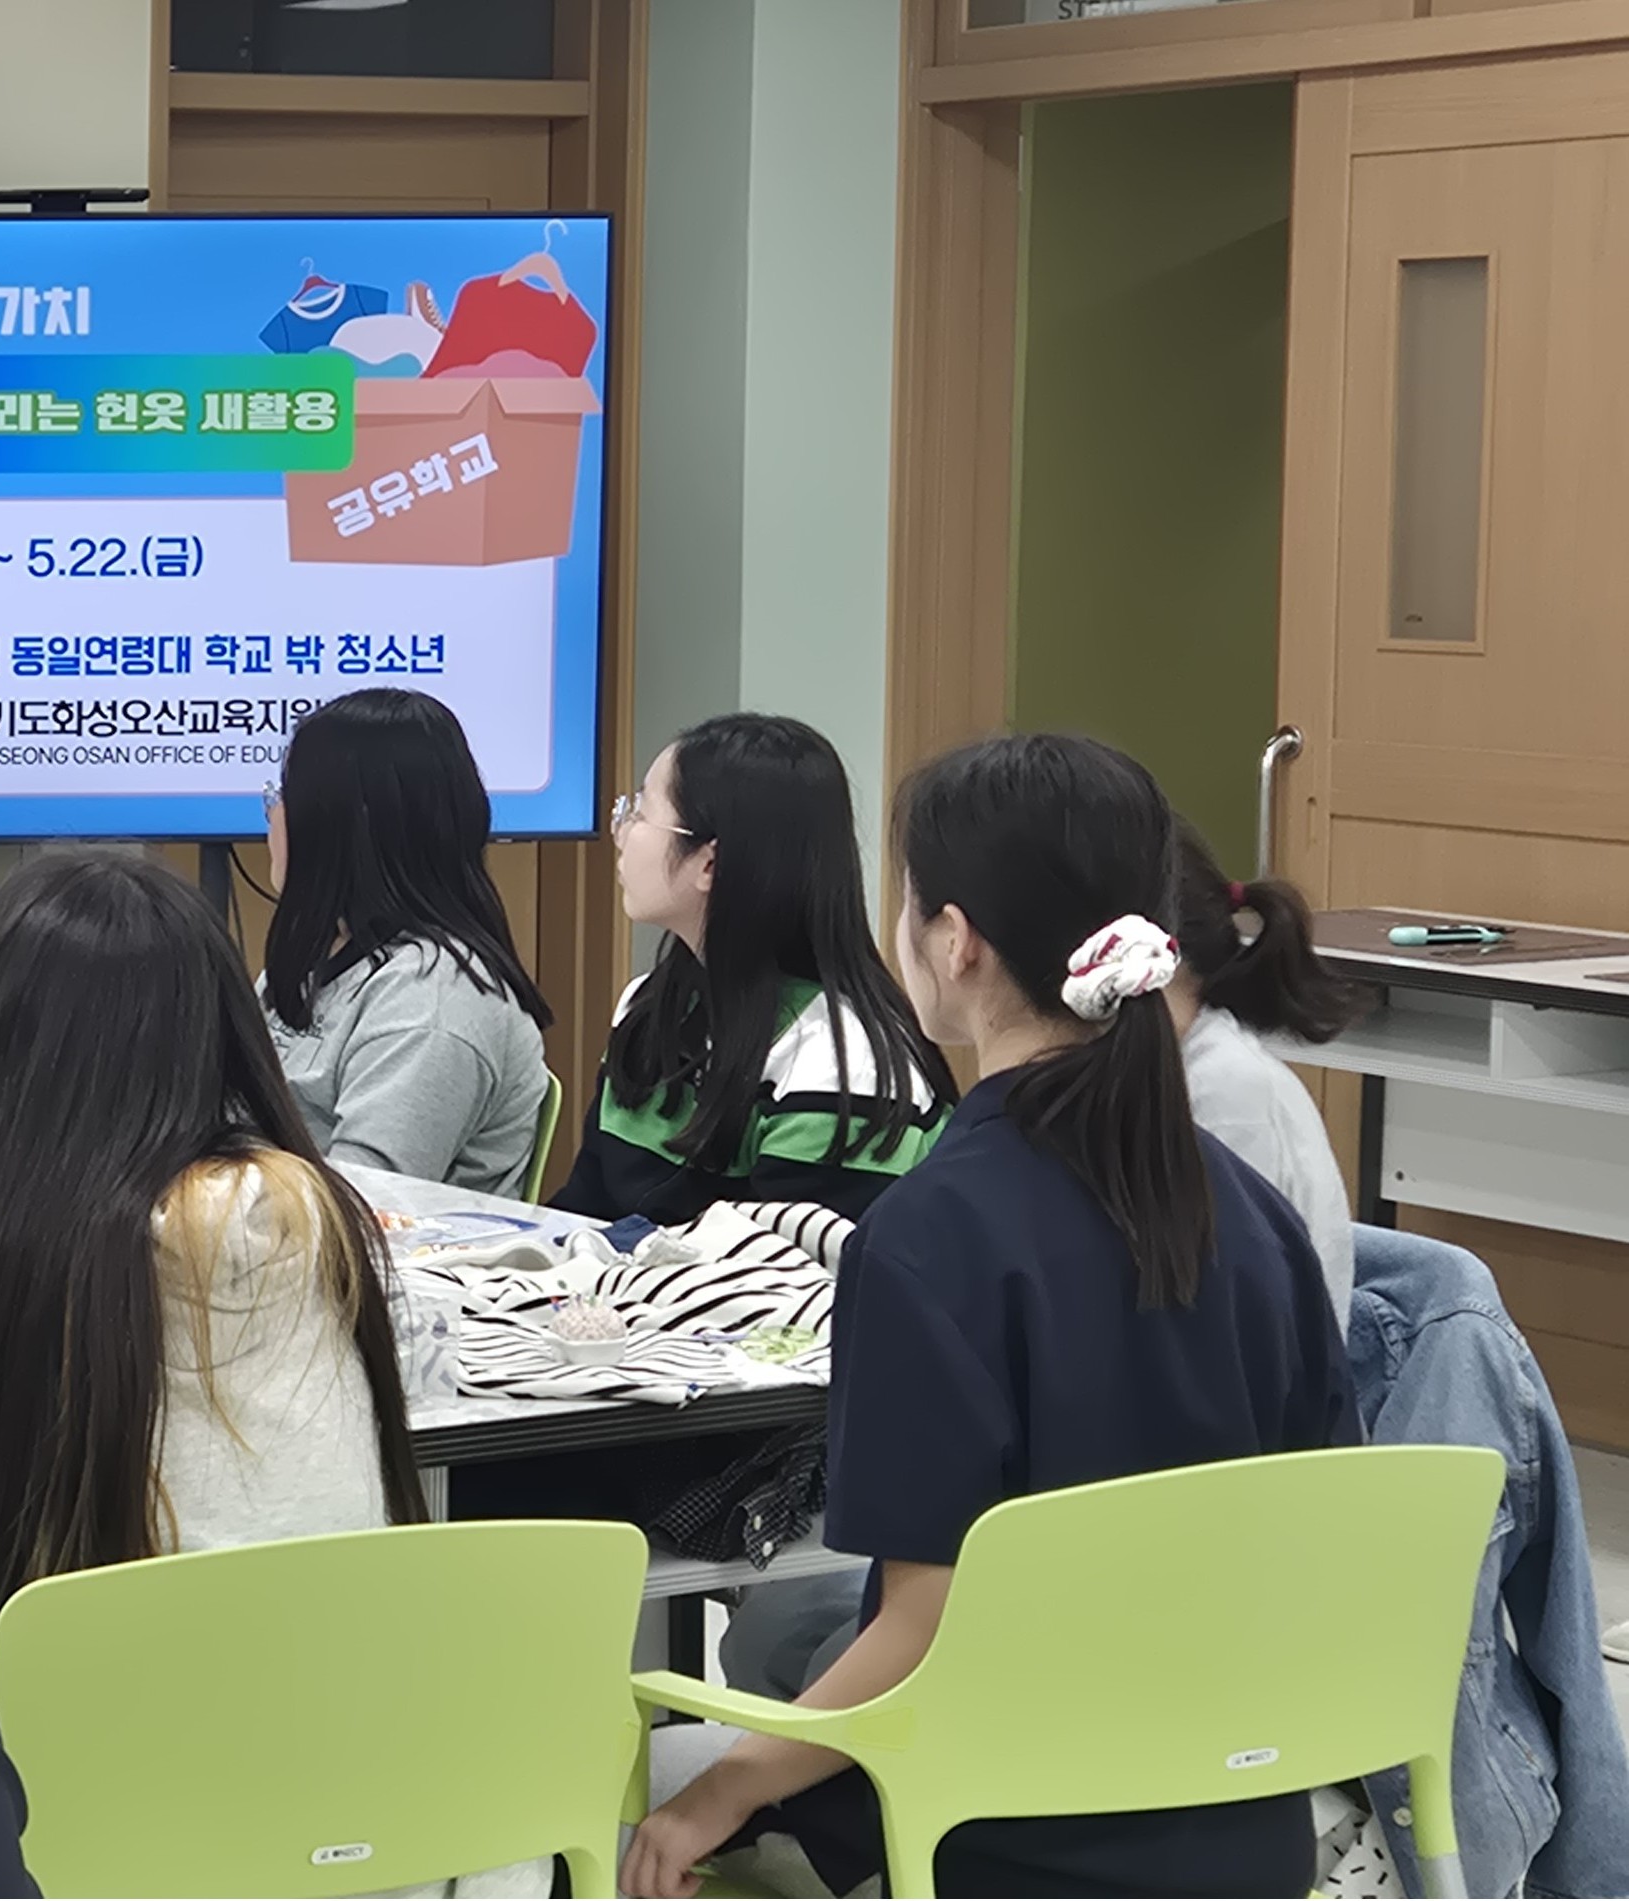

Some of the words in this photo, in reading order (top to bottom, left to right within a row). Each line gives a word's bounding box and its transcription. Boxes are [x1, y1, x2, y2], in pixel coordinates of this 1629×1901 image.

[95, 391, 186, 433] 헌옷
[200, 391, 337, 433] 새활용
[326, 433, 499, 537] 공유학교
[27, 536, 204, 577] 5.22.(금)
[11, 635, 191, 676] 동일연령대
[204, 634, 271, 675] 학교
[286, 634, 325, 675] 밖
[337, 634, 445, 674] 청소년
[73, 746, 130, 764] OSAN
[134, 746, 204, 764] OFFICE
[209, 746, 235, 763] OF
[241, 745, 287, 763] EDU
